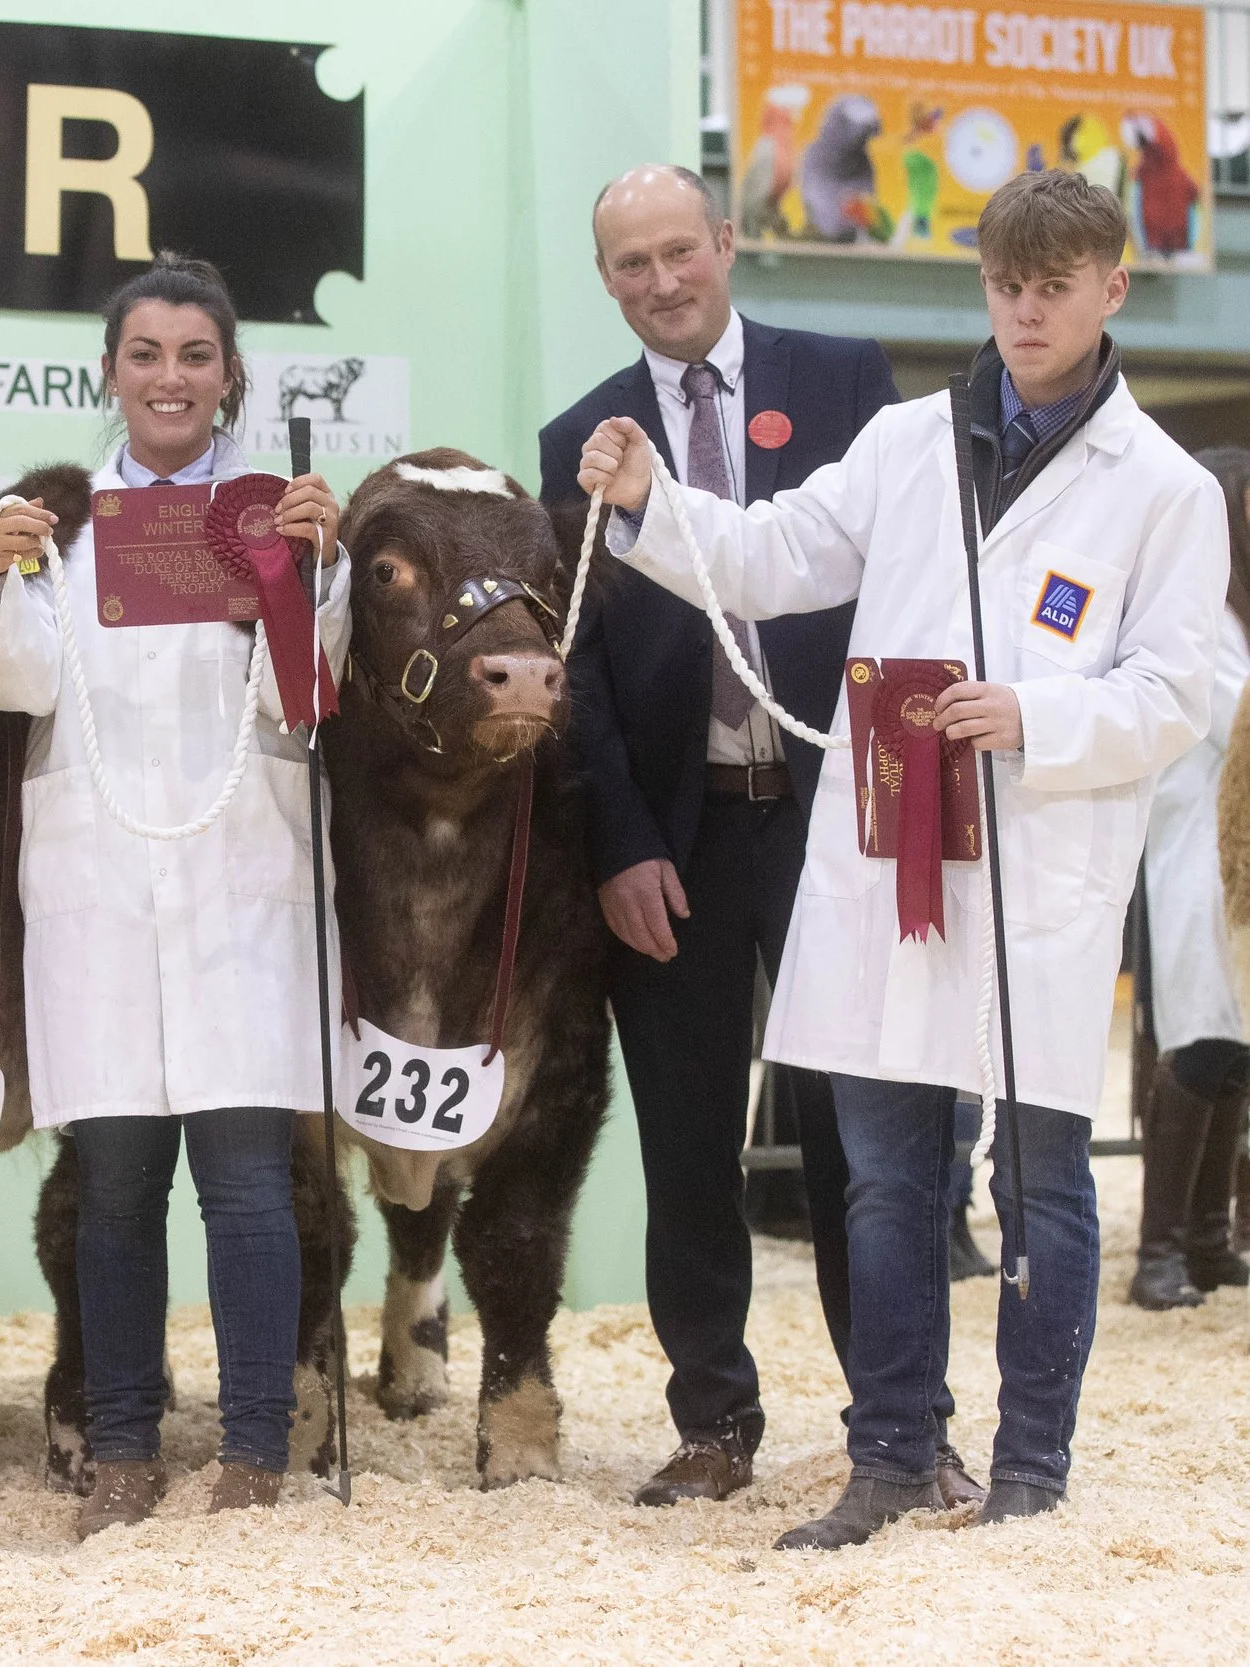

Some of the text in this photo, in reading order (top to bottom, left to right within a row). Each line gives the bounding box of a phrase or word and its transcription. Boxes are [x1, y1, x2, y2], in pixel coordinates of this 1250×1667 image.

[772, 0, 1177, 79] THE PARROT SOCIETY UK
[158, 503, 211, 518] ENGLIS
[143, 520, 205, 537] WINTER
[118, 553, 144, 565] THE
[147, 550, 192, 563] ROYAL
[134, 563, 171, 575] DUKE
[175, 561, 192, 573] OF
[159, 571, 235, 585] PERPETUAL
[170, 581, 225, 595] TROPHY
[1041, 606, 1075, 629] ALDI
[354, 1050, 470, 1134] 232
